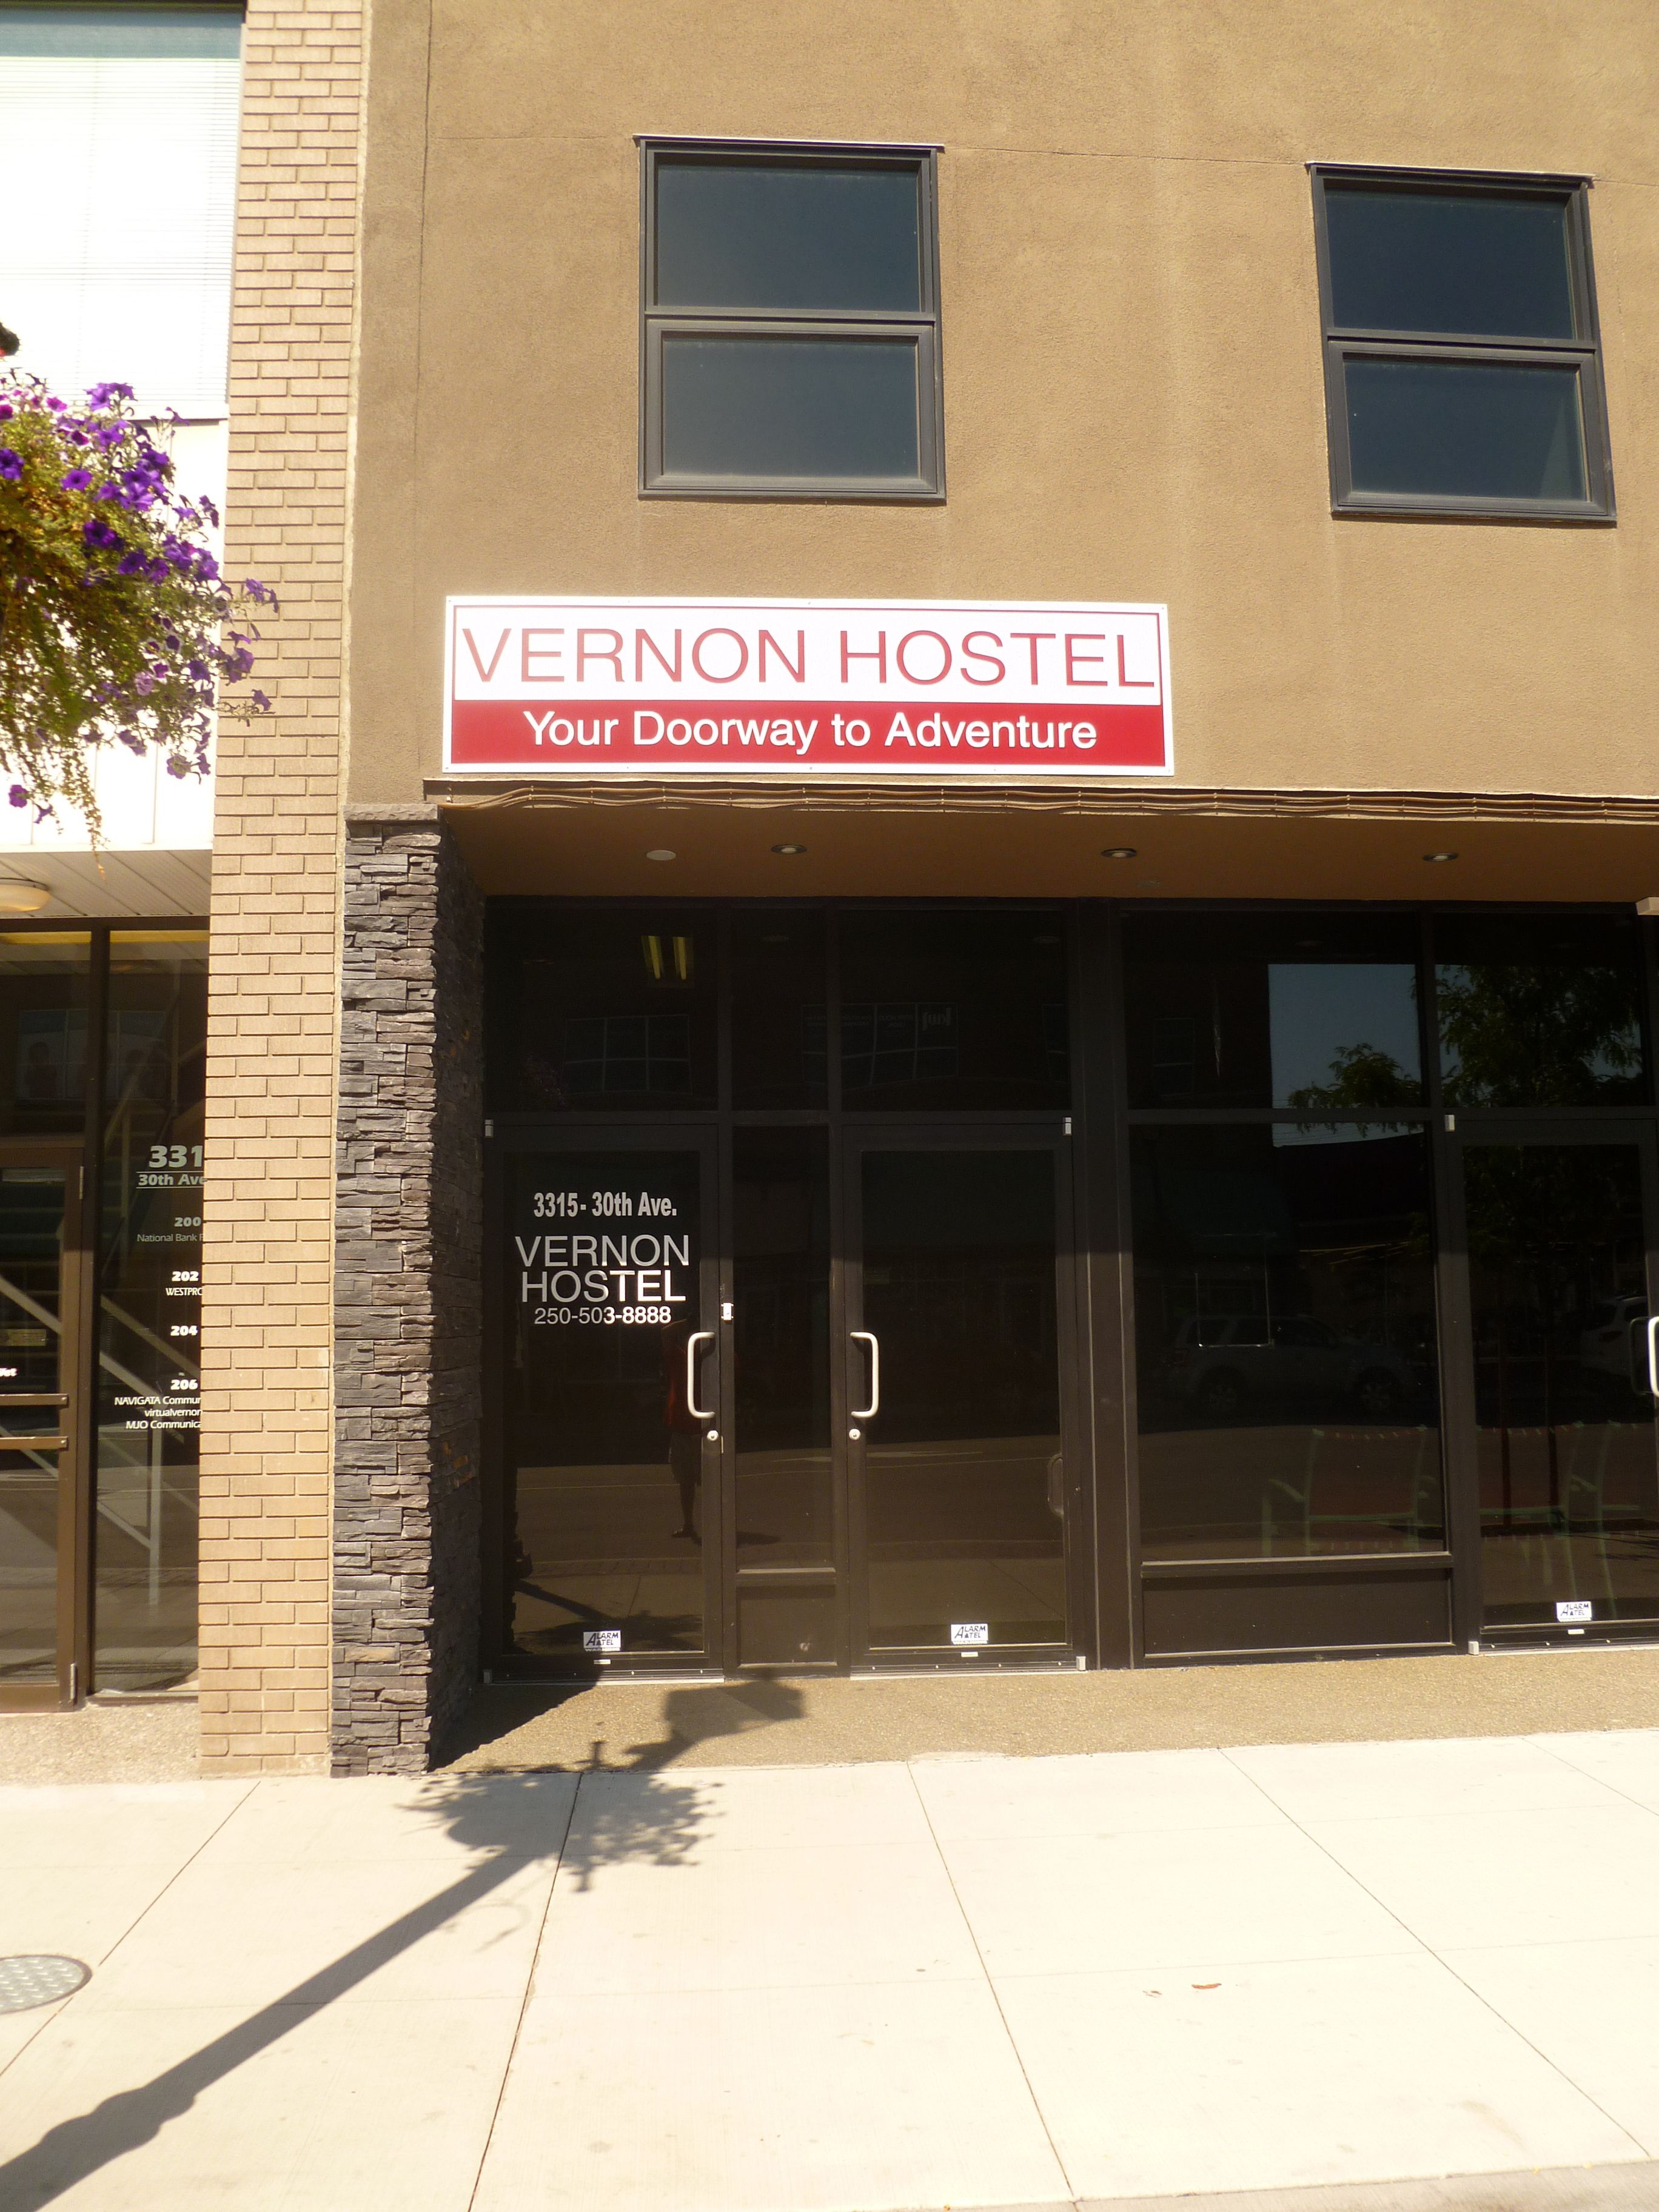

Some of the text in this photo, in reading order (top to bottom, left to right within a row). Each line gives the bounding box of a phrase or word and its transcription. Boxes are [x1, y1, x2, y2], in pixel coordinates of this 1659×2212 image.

[462, 628, 1155, 687] VERNON HOSTEL
[523, 710, 1097, 755] Your Doorway to Adventure
[138, 1174, 174, 1186] 30th
[592, 1191, 632, 1216] 30th
[638, 1192, 677, 1216] Ave.
[174, 1216, 201, 1227] 200
[137, 1233, 173, 1242] National
[515, 1235, 689, 1267] VERNON
[172, 1271, 199, 1281] 202
[522, 1270, 686, 1302] HOSTEL
[534, 1306, 671, 1324] 250-503-8888
[170, 1326, 198, 1336] 204
[170, 1379, 198, 1390] 206
[114, 1396, 161, 1406] NAVIGATA
[126, 1421, 148, 1429] MJO
[954, 1625, 986, 1639] ALARM
[585, 1632, 618, 1646] ALARM
